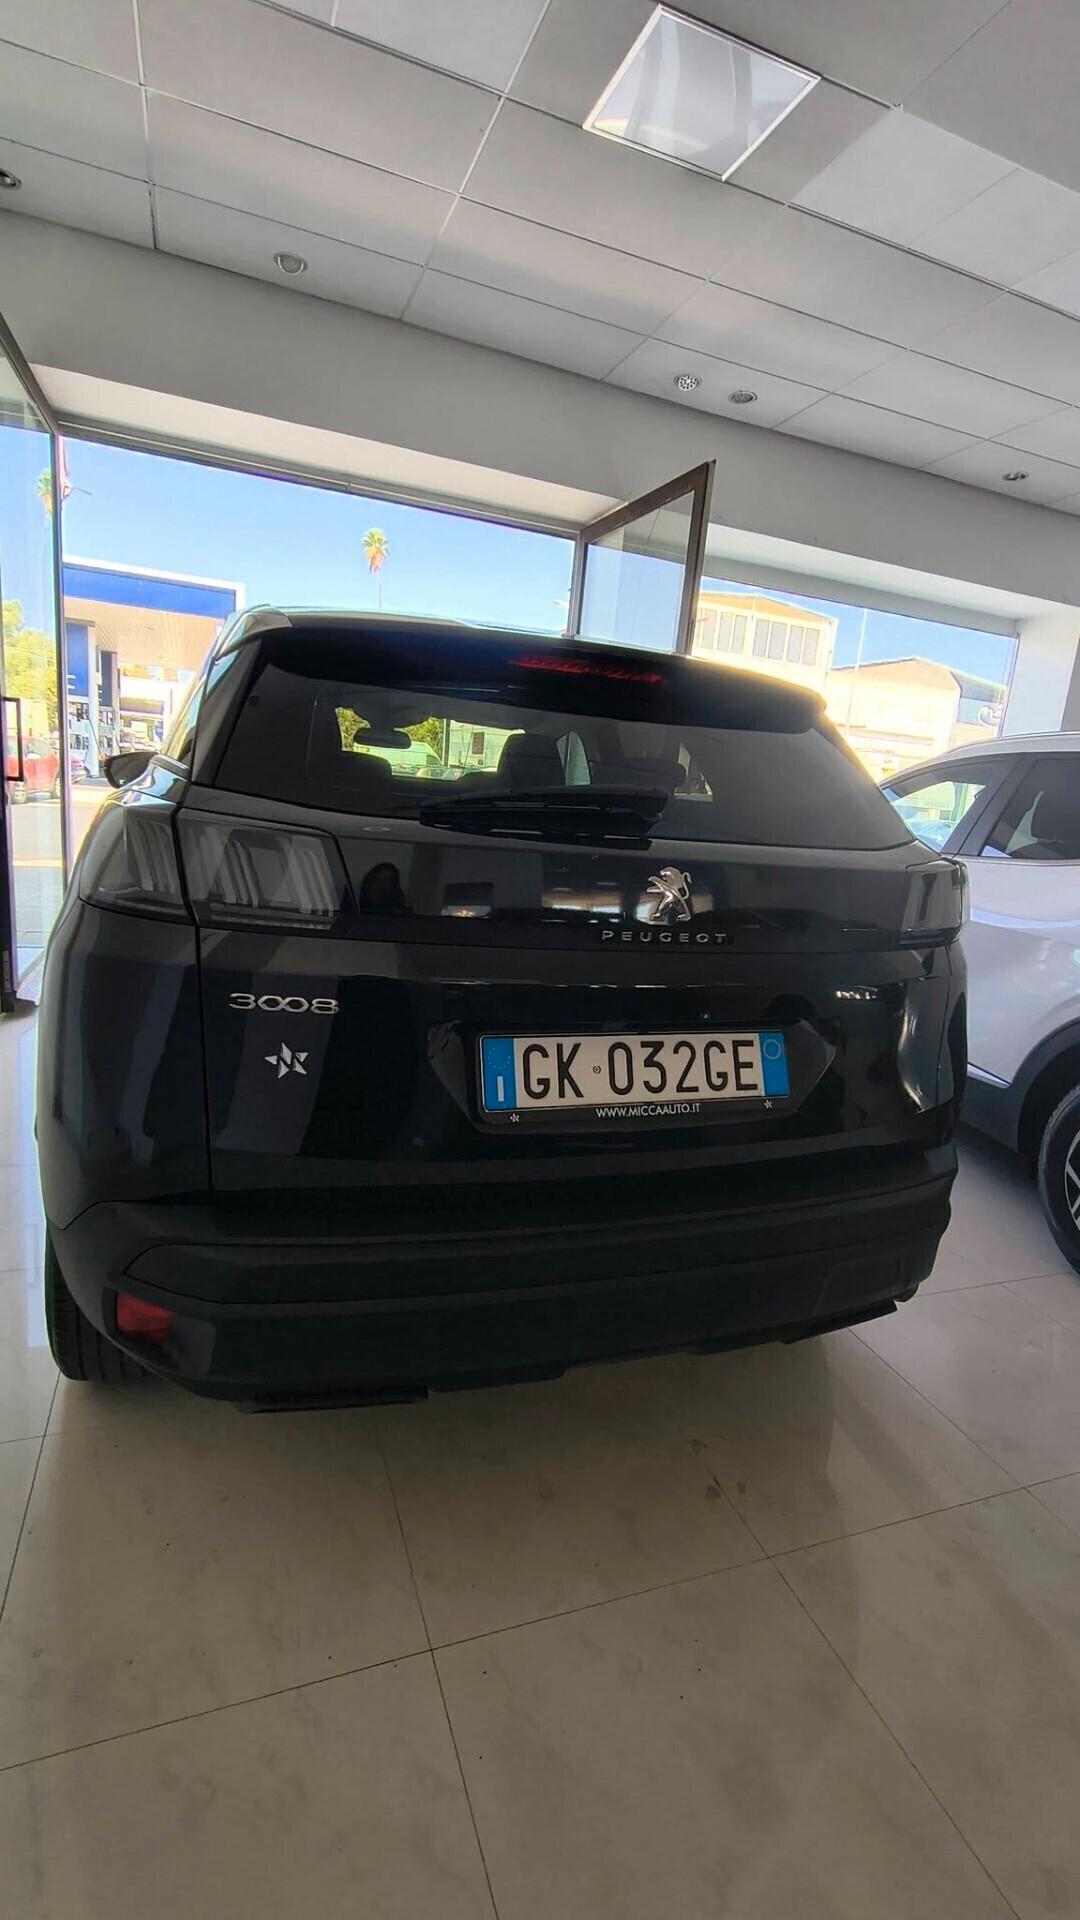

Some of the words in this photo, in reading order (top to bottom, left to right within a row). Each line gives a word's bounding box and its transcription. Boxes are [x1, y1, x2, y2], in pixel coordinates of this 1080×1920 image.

[602, 930, 727, 944] PEUGEOT
[229, 993, 339, 1014] 3008
[522, 1043, 584, 1099] GK
[497, 1075, 505, 1102] I
[596, 1103, 701, 1119] WWW.MICCAAUTO.IT
